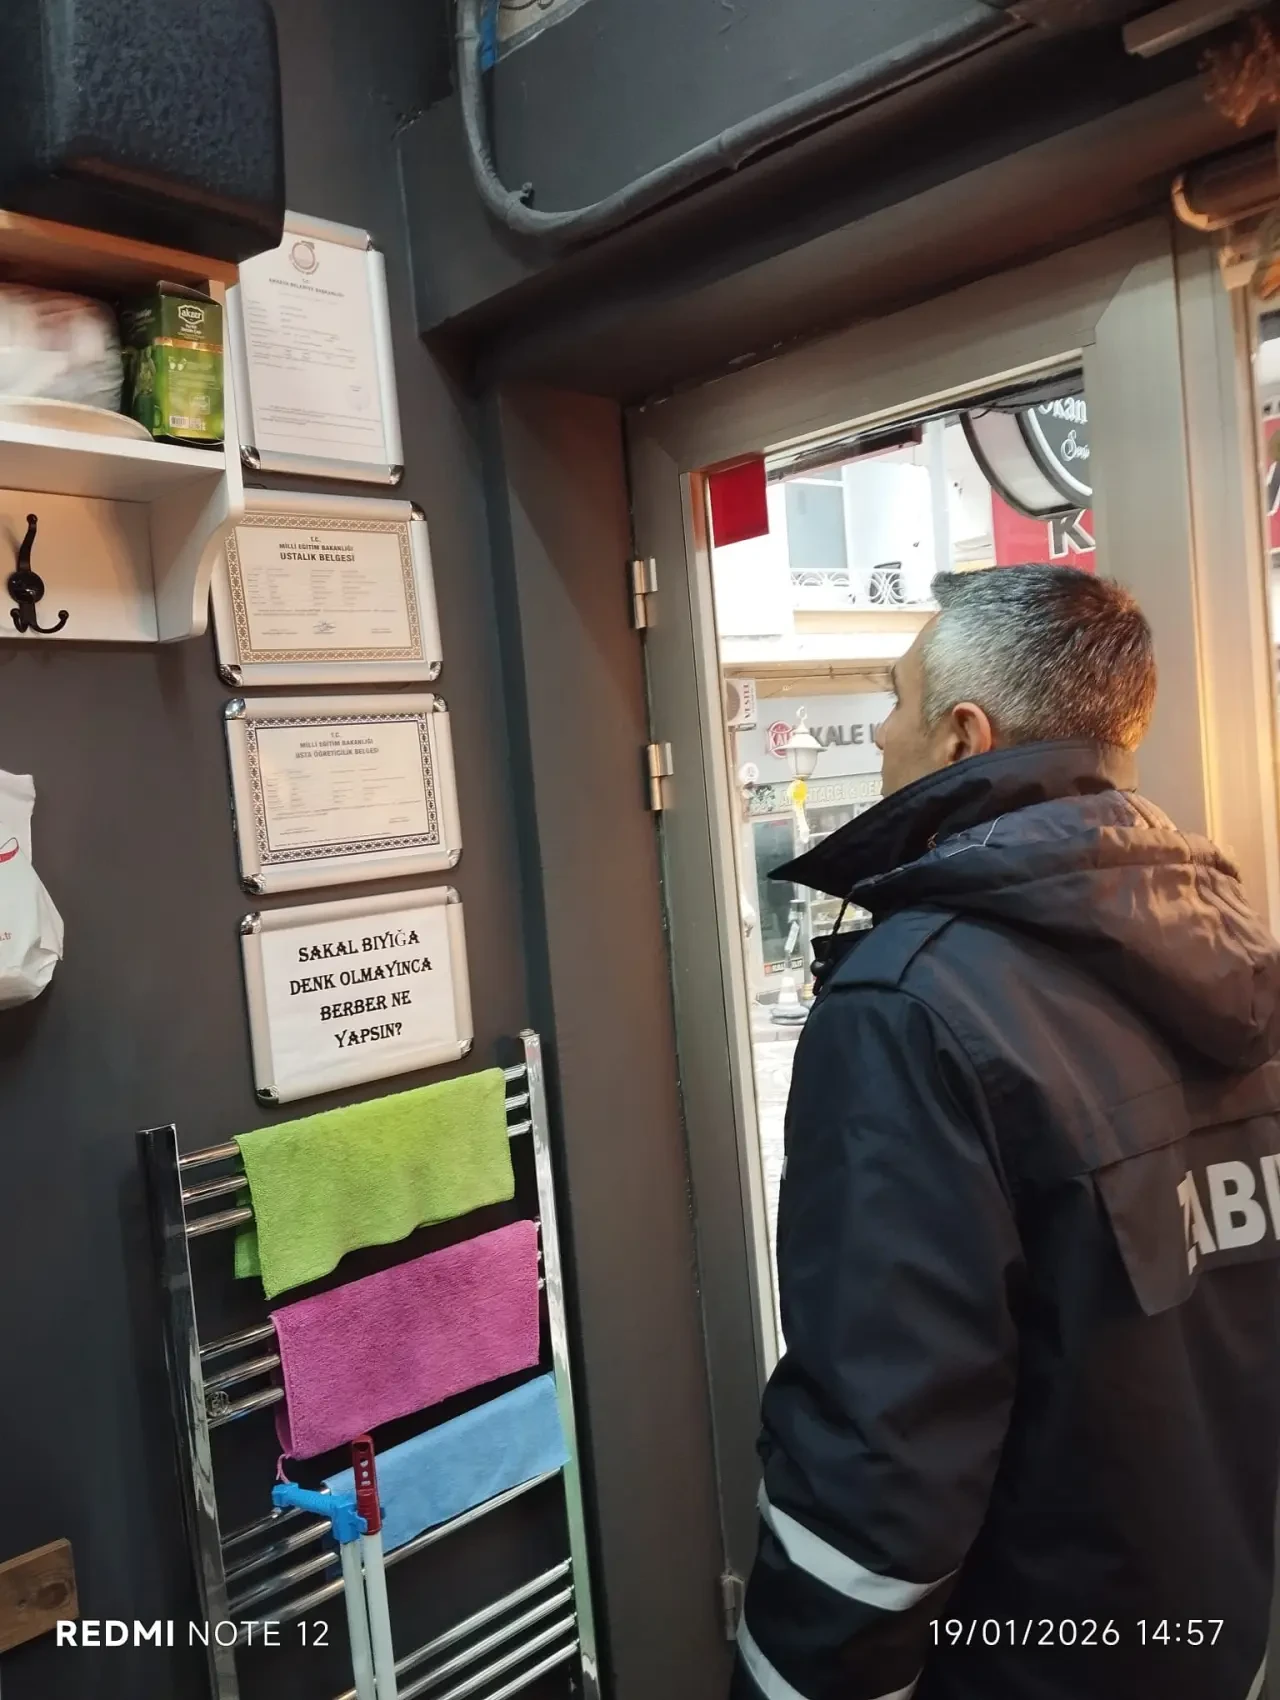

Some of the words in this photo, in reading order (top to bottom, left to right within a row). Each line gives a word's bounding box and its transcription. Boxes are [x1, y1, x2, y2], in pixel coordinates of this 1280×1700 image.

[280, 552, 317, 562] USTALIK
[809, 723, 863, 747] KALE
[298, 940, 359, 962] SAKAL
[362, 929, 420, 952] BIYIĞA
[290, 974, 336, 995] DENK
[340, 957, 433, 986] OLMAYINCA
[320, 995, 388, 1021] BERBER
[391, 990, 412, 1007] NE
[334, 1022, 403, 1048] YAPSIN?
[1176, 1152, 1280, 1276] ABI
